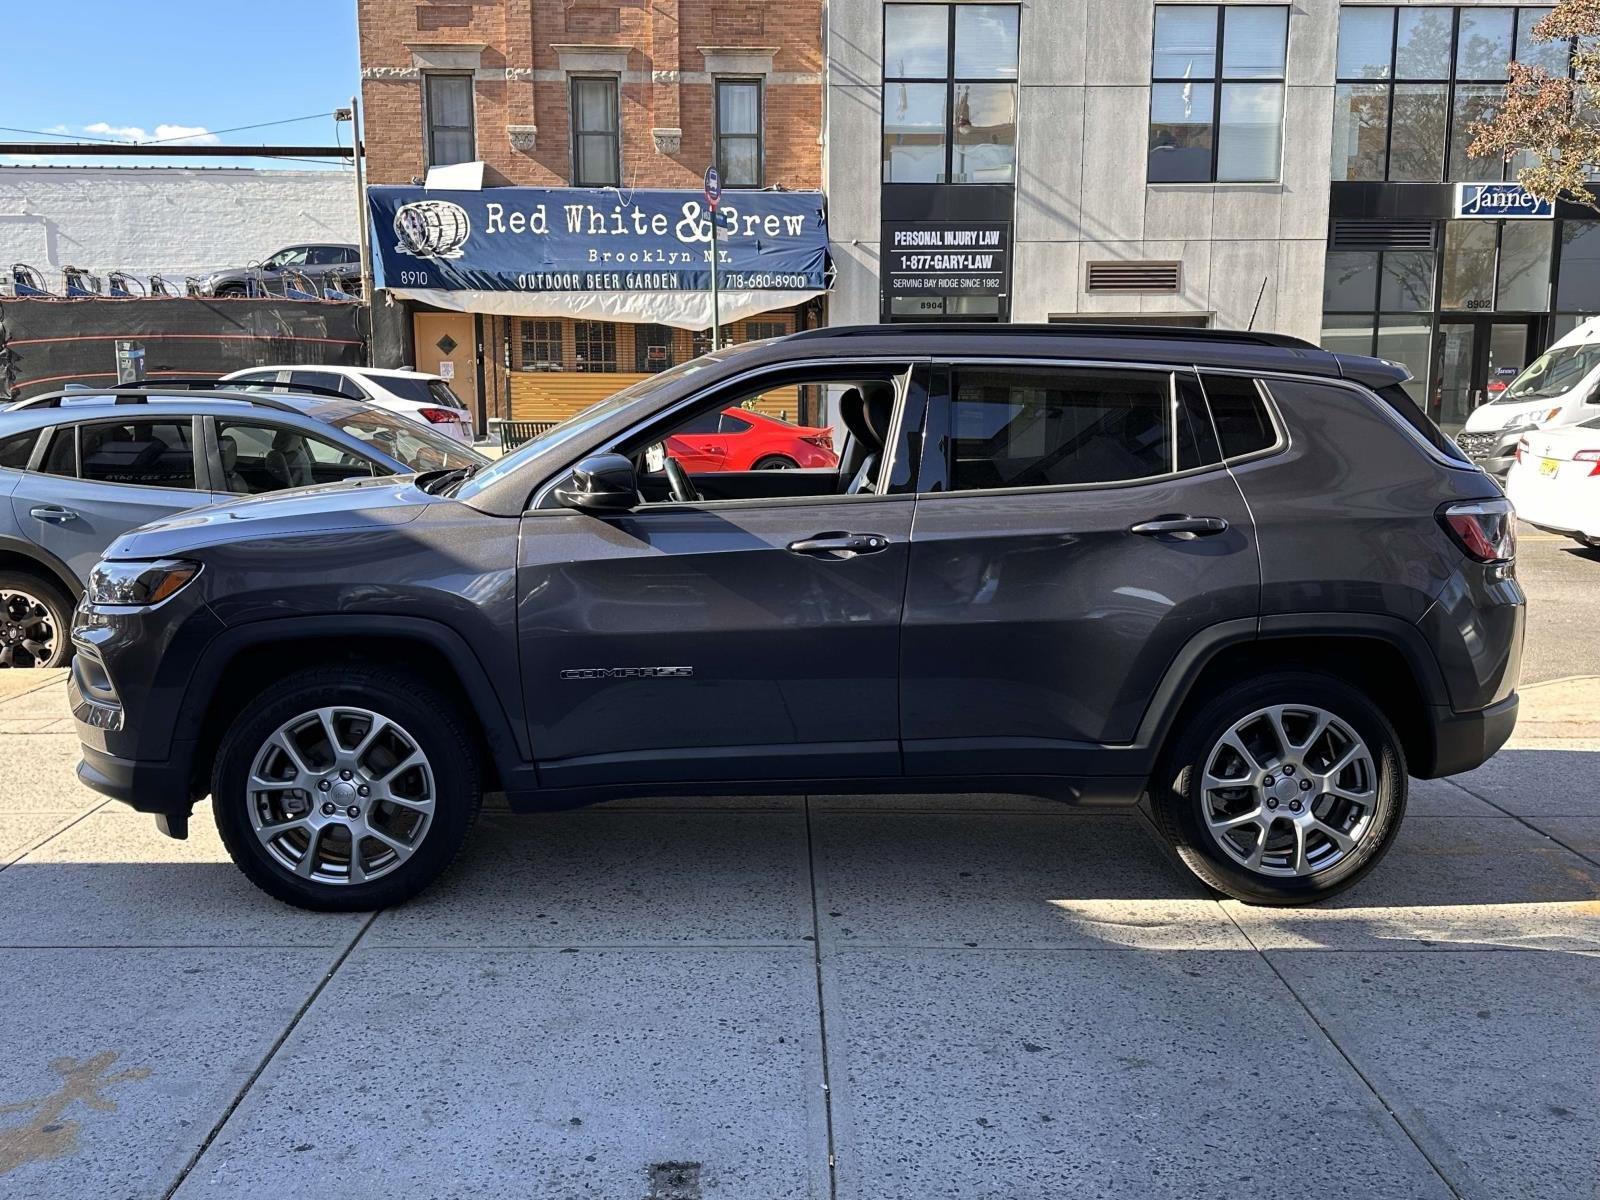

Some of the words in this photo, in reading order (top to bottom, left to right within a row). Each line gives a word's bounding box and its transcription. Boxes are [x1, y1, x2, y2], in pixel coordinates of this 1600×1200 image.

[1469, 186, 1544, 214] Janney
[485, 203, 549, 234] Red
[564, 205, 668, 235] White
[675, 201, 713, 243] &
[720, 206, 805, 237] Brew
[894, 231, 942, 246] PERSONAL
[944, 231, 977, 245] INJURY
[979, 230, 1000, 245] LAW
[589, 249, 691, 265] Brooklyn
[703, 250, 732, 263] NY.
[900, 254, 993, 269] 1-877-GARY-LAW
[400, 270, 428, 285] 8910
[518, 274, 579, 290] OUTDOOR
[586, 273, 619, 289] BEER
[626, 273, 678, 289] GARDEN
[726, 274, 805, 289] 718-680-8900
[893, 279, 922, 288] SERVING
[923, 279, 937, 288] BAY
[938, 279, 959, 288] RIDGE
[960, 279, 981, 288] SINCE
[982, 278, 1000, 288] 1982
[1466, 300, 1491, 309] 8902
[559, 666, 694, 680] COMPASS
